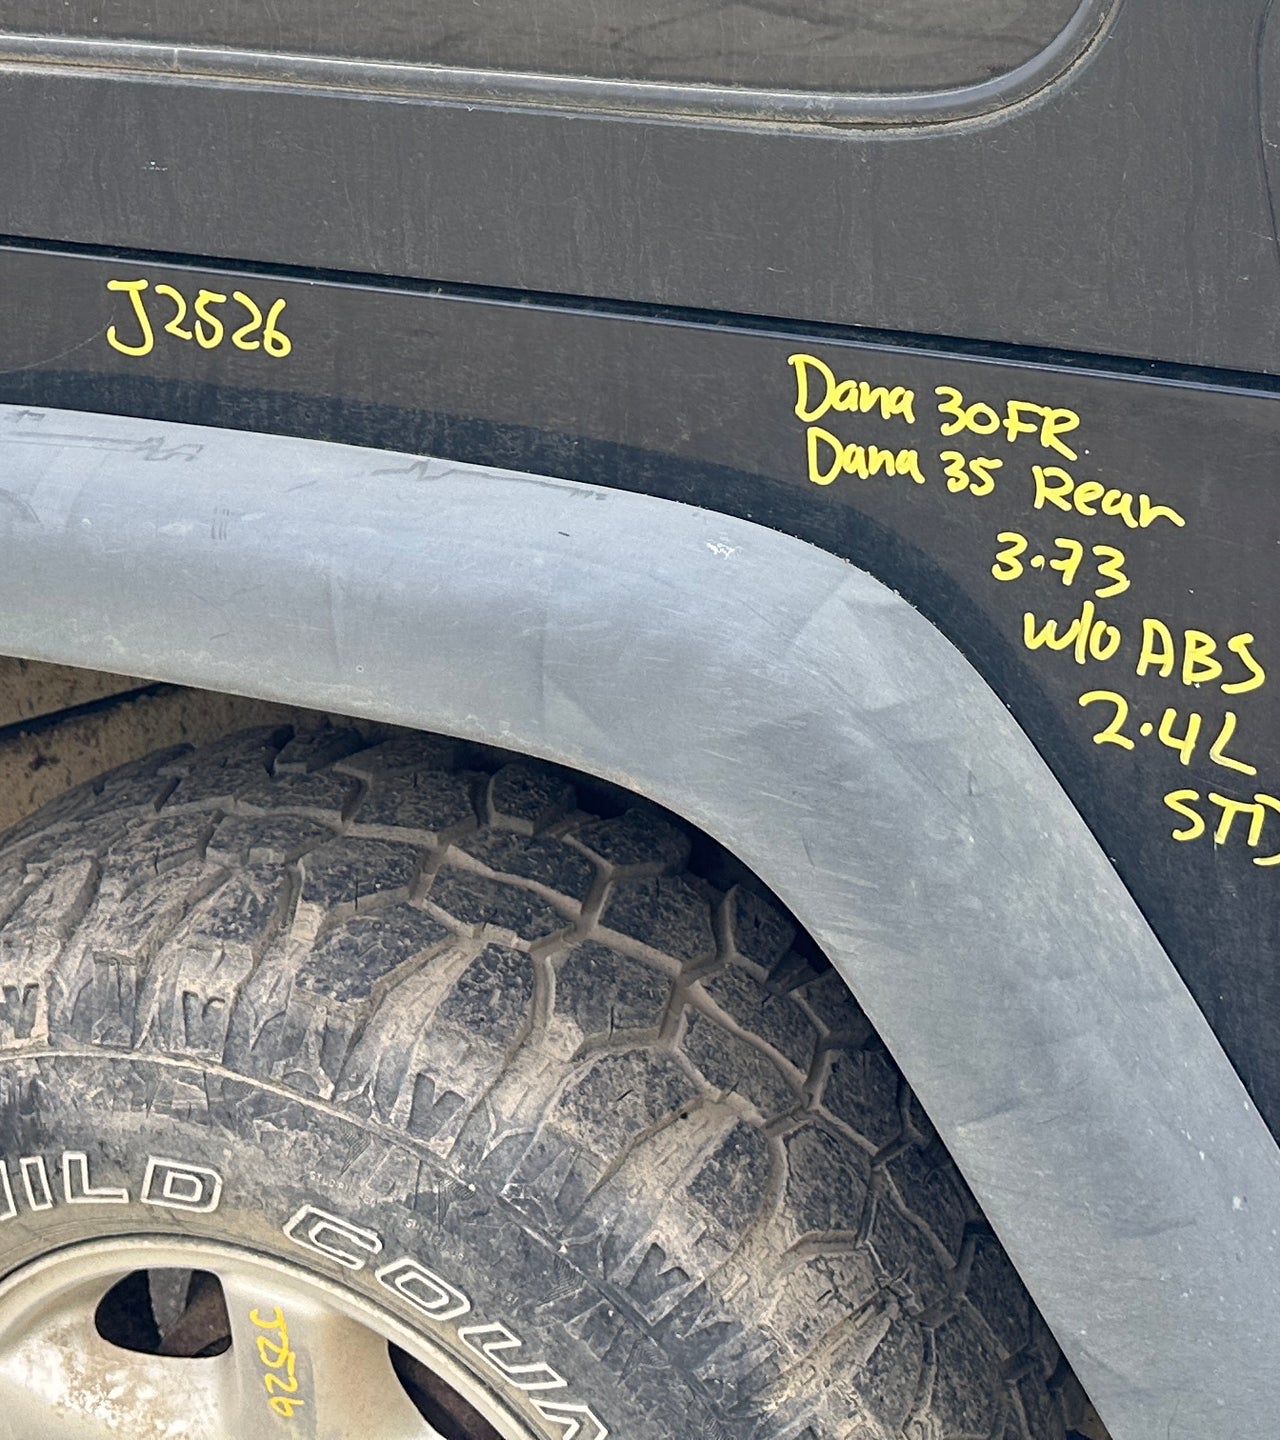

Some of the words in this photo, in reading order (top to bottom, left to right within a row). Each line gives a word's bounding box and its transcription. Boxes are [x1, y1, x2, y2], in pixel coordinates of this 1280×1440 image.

[106, 279, 292, 359] J2526
[788, 353, 916, 423] Dana
[806, 426, 925, 486] Dana
[939, 450, 1003, 496] 35
[1031, 465, 1186, 528] Rear
[1136, 618, 1266, 694] ABS
[1077, 689, 1258, 775] 2.4L
